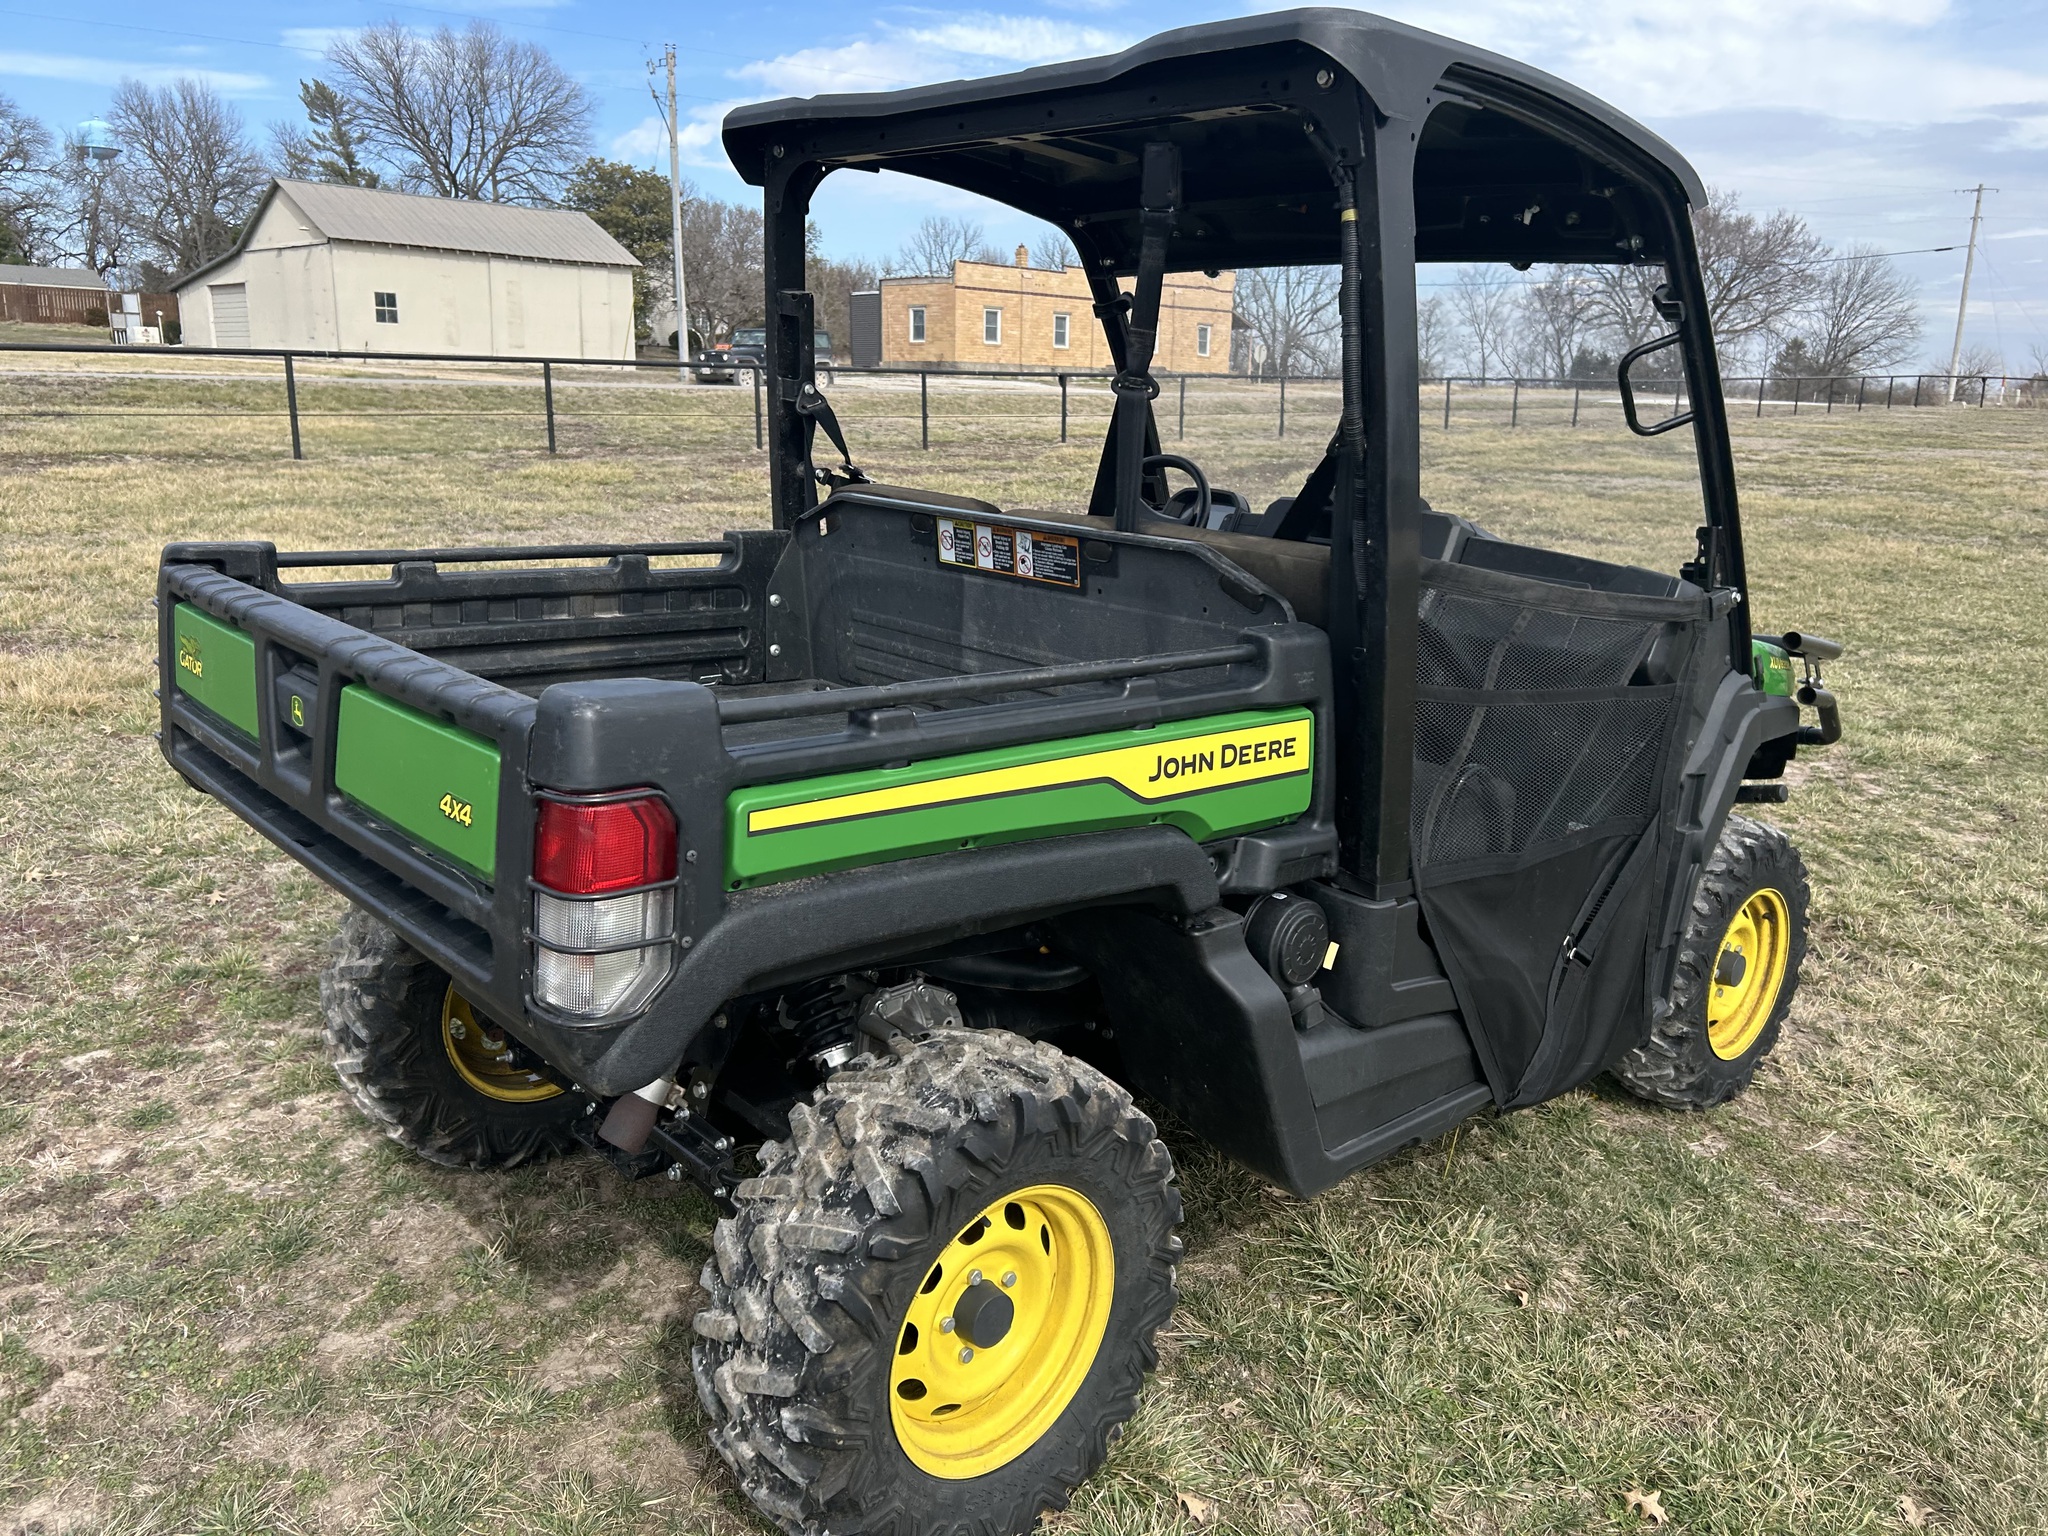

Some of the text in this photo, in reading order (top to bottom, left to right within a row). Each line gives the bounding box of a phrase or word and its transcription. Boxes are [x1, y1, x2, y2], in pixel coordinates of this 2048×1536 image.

[179, 650, 203, 678] GATOR
[1148, 737, 1296, 782] JOHN DEERE
